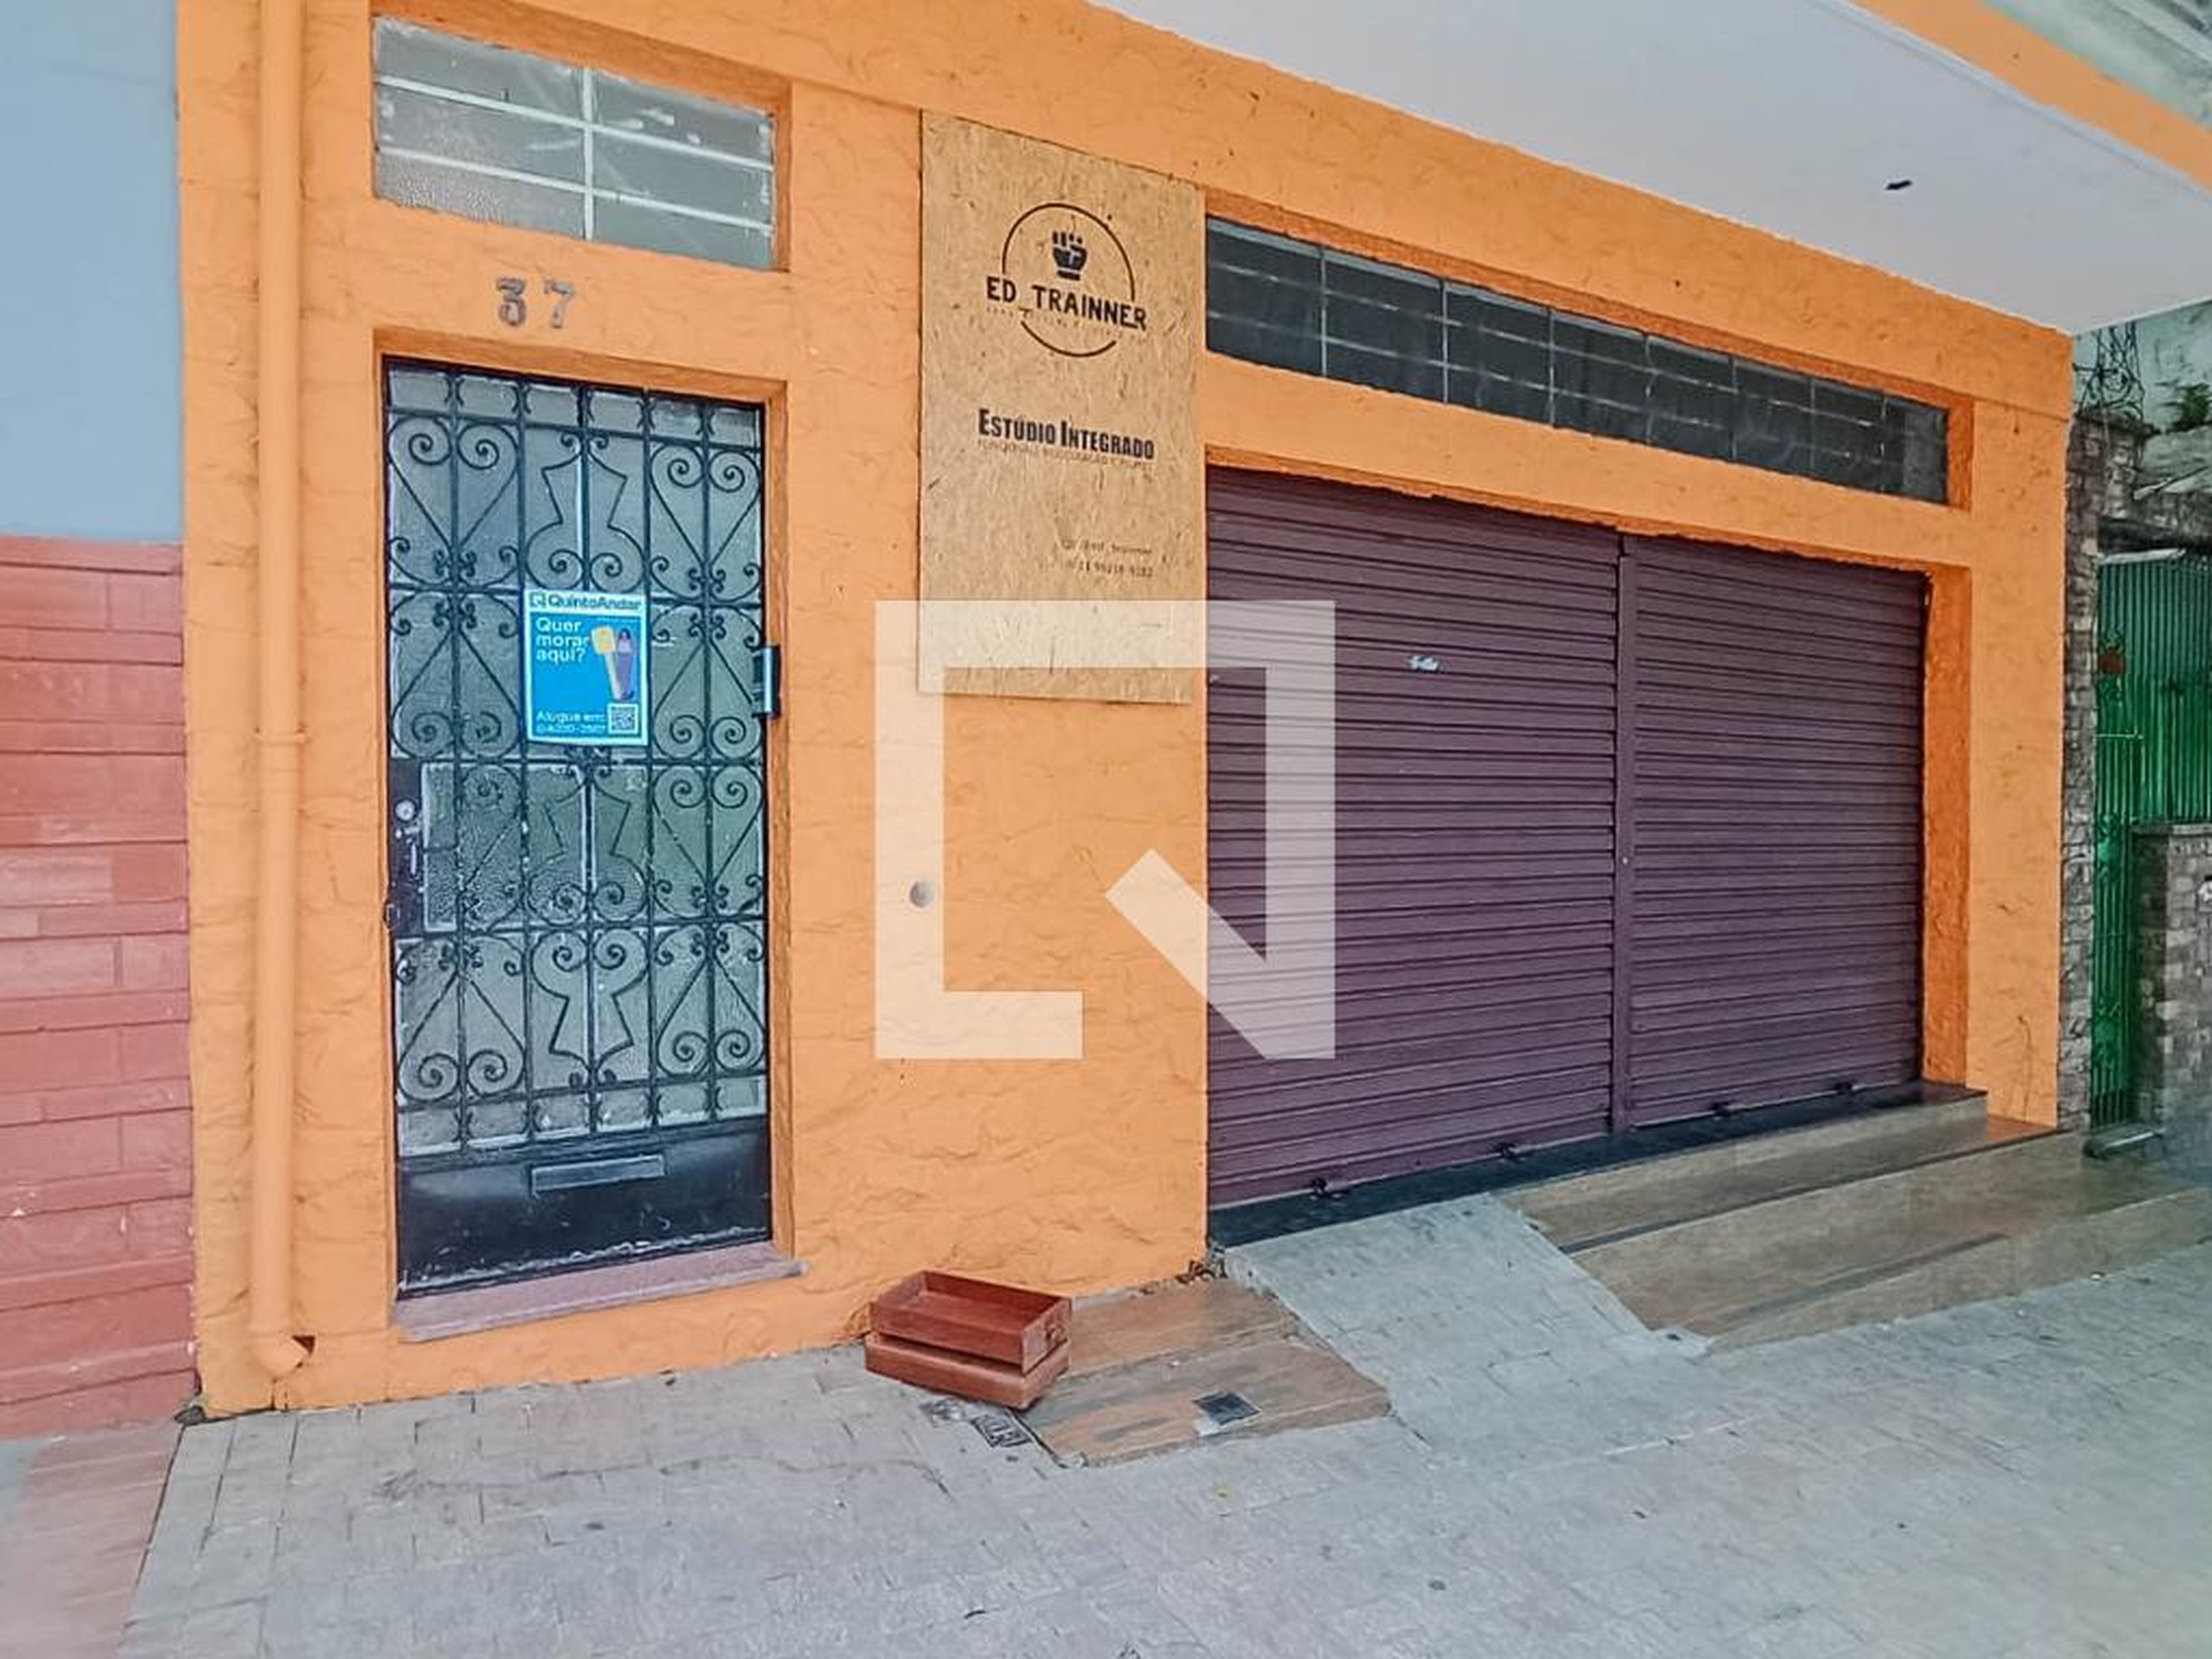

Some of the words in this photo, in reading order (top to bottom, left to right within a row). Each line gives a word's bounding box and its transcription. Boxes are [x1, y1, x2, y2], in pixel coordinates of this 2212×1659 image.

[495, 278, 575, 329] 37
[986, 276, 1017, 303] ED
[1032, 285, 1147, 330] TRAINNER
[548, 594, 642, 610] QuintoAndar
[536, 617, 582, 632] Quer
[536, 635, 589, 647] morar
[536, 648, 586, 663] aqui?
